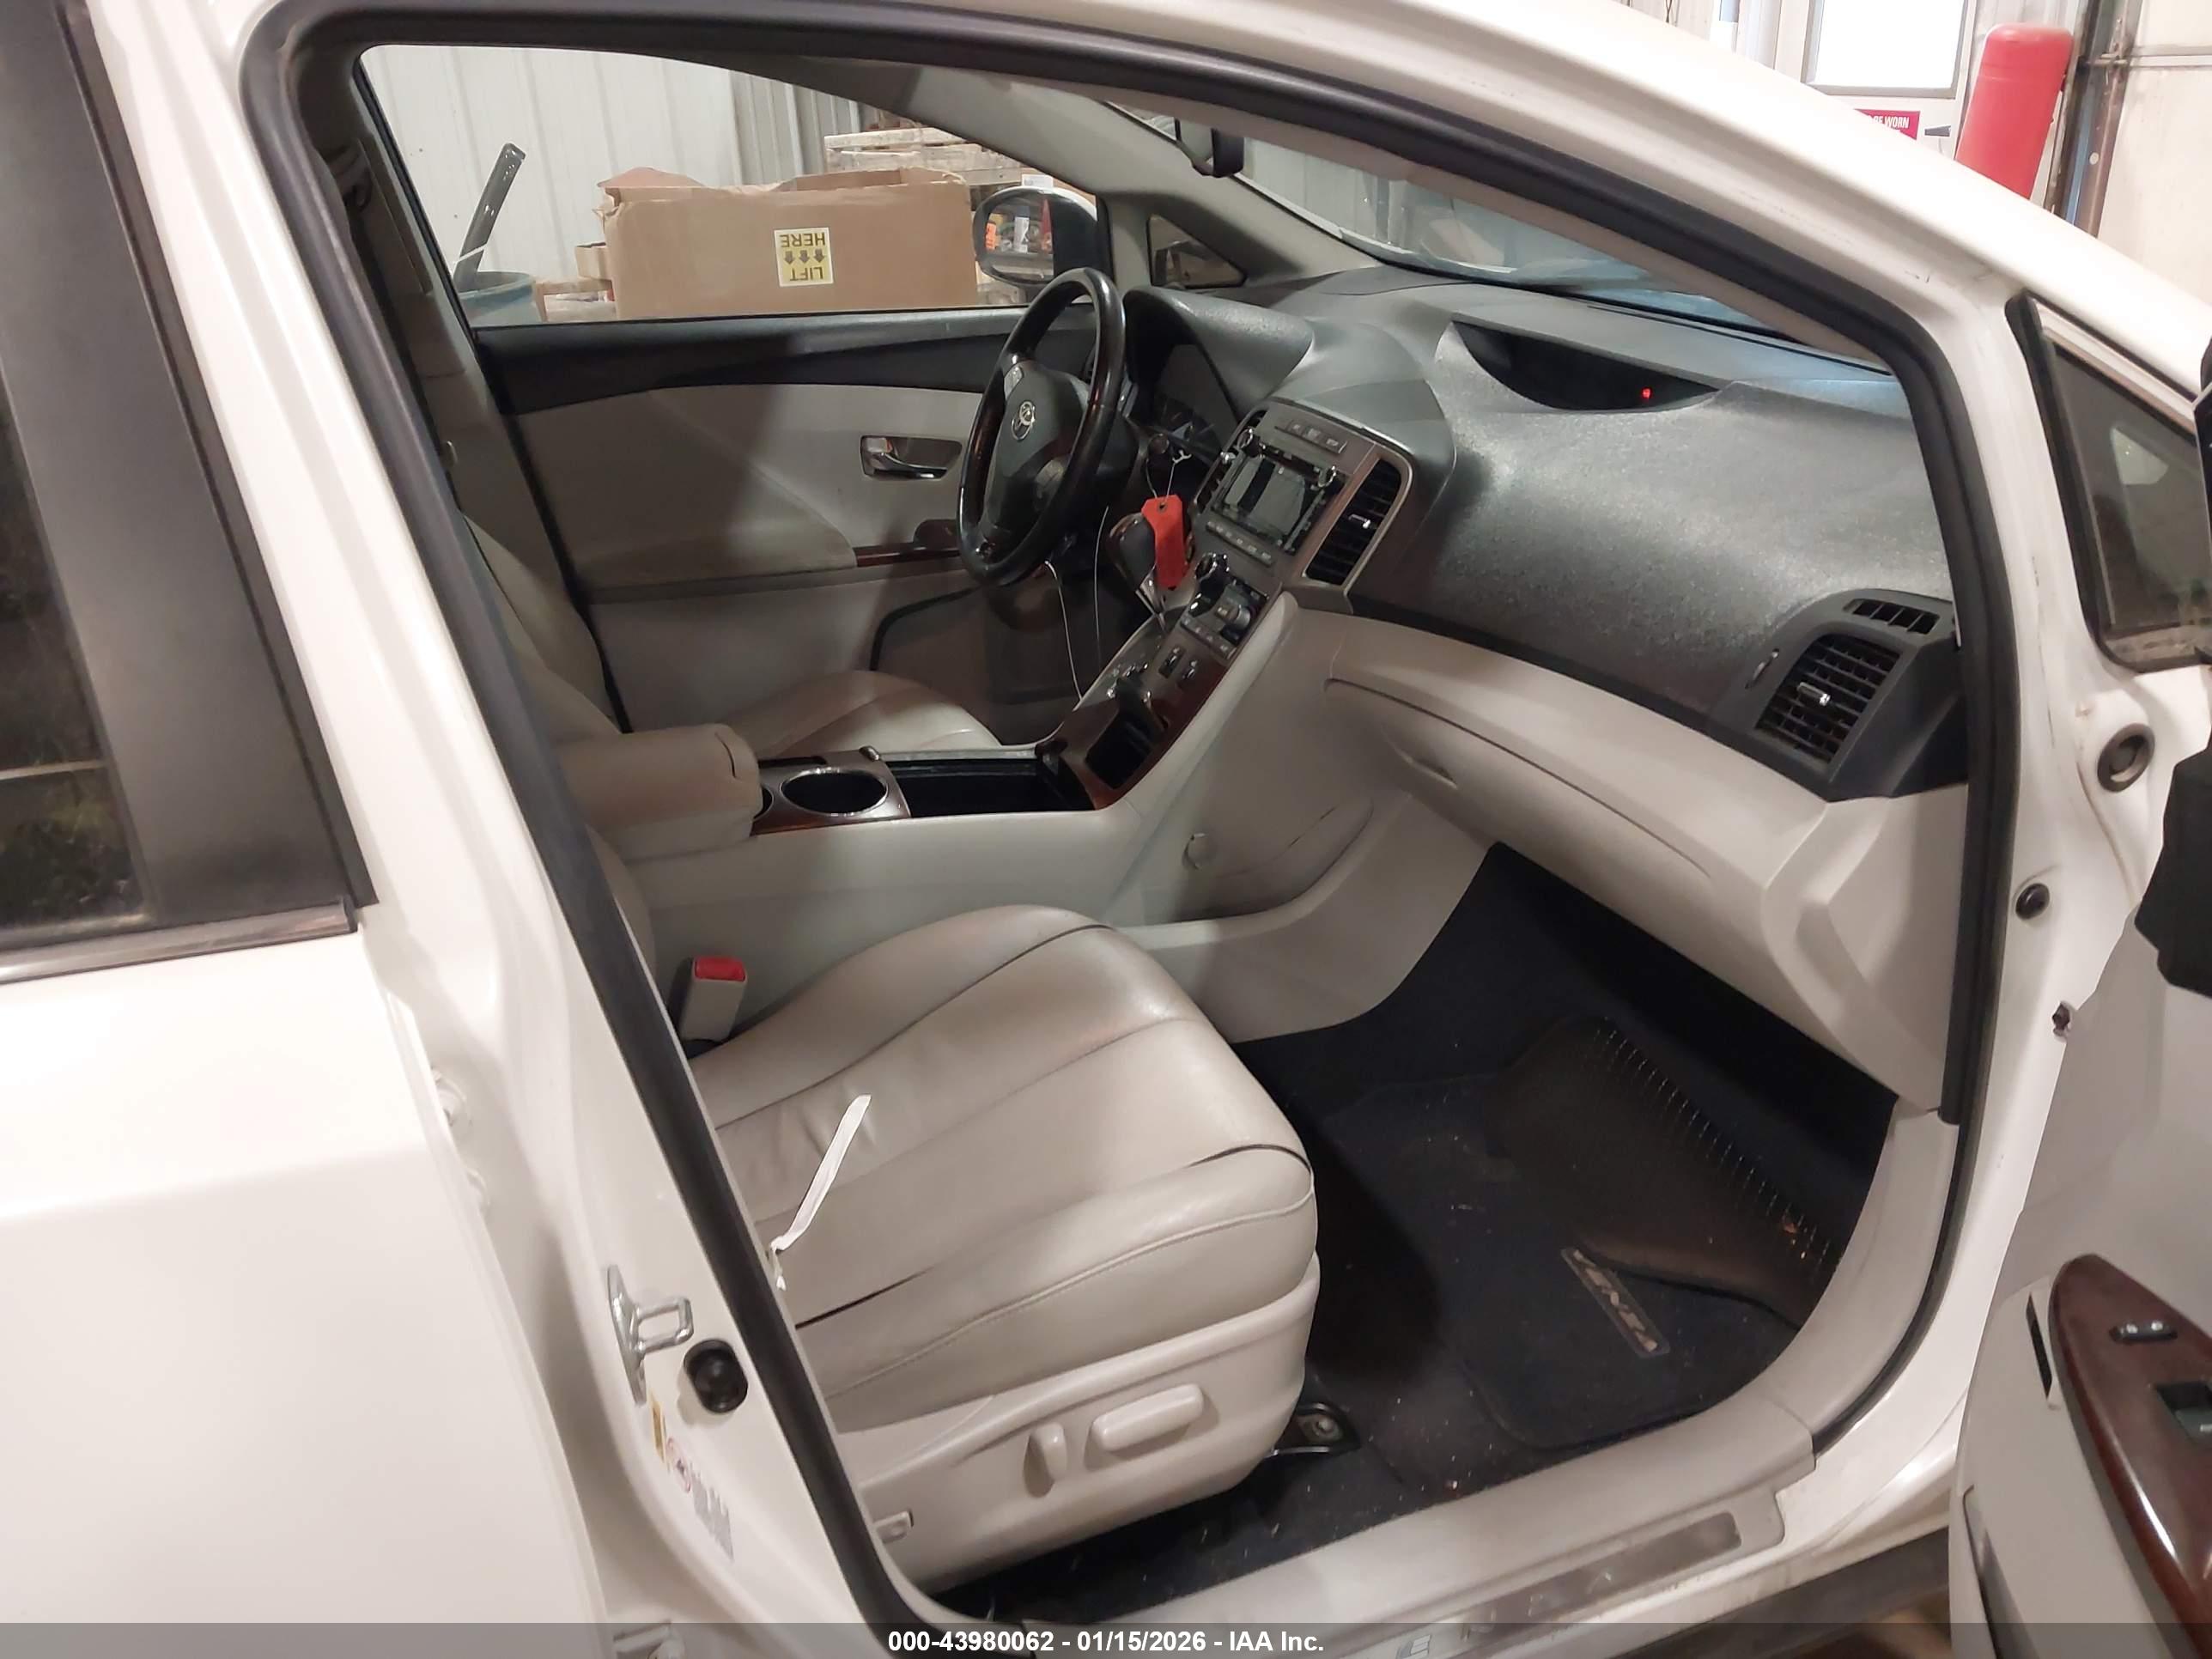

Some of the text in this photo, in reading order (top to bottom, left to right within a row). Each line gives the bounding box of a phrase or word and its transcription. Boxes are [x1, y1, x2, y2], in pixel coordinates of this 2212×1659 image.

[1884, 116, 1909, 128] WORN
[779, 232, 826, 248] HERE
[789, 266, 823, 282] LIFT
